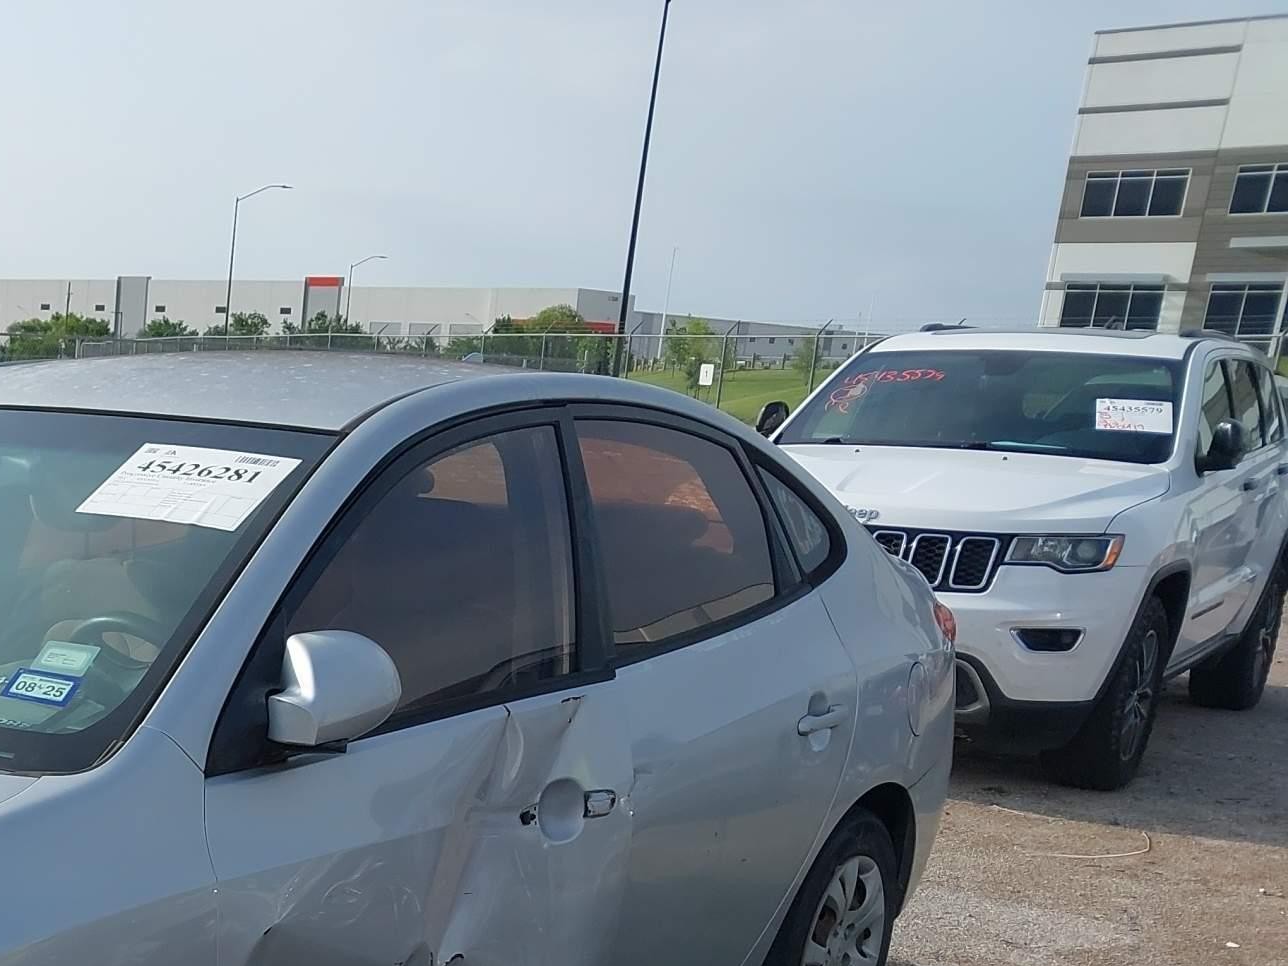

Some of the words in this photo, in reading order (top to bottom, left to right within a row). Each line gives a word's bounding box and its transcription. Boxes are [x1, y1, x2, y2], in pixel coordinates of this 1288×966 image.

[1103, 405, 1164, 414] 45435579
[137, 459, 263, 484] 45426281
[845, 504, 880, 521] eep
[15, 680, 37, 693] 08
[42, 685, 67, 698] 25
